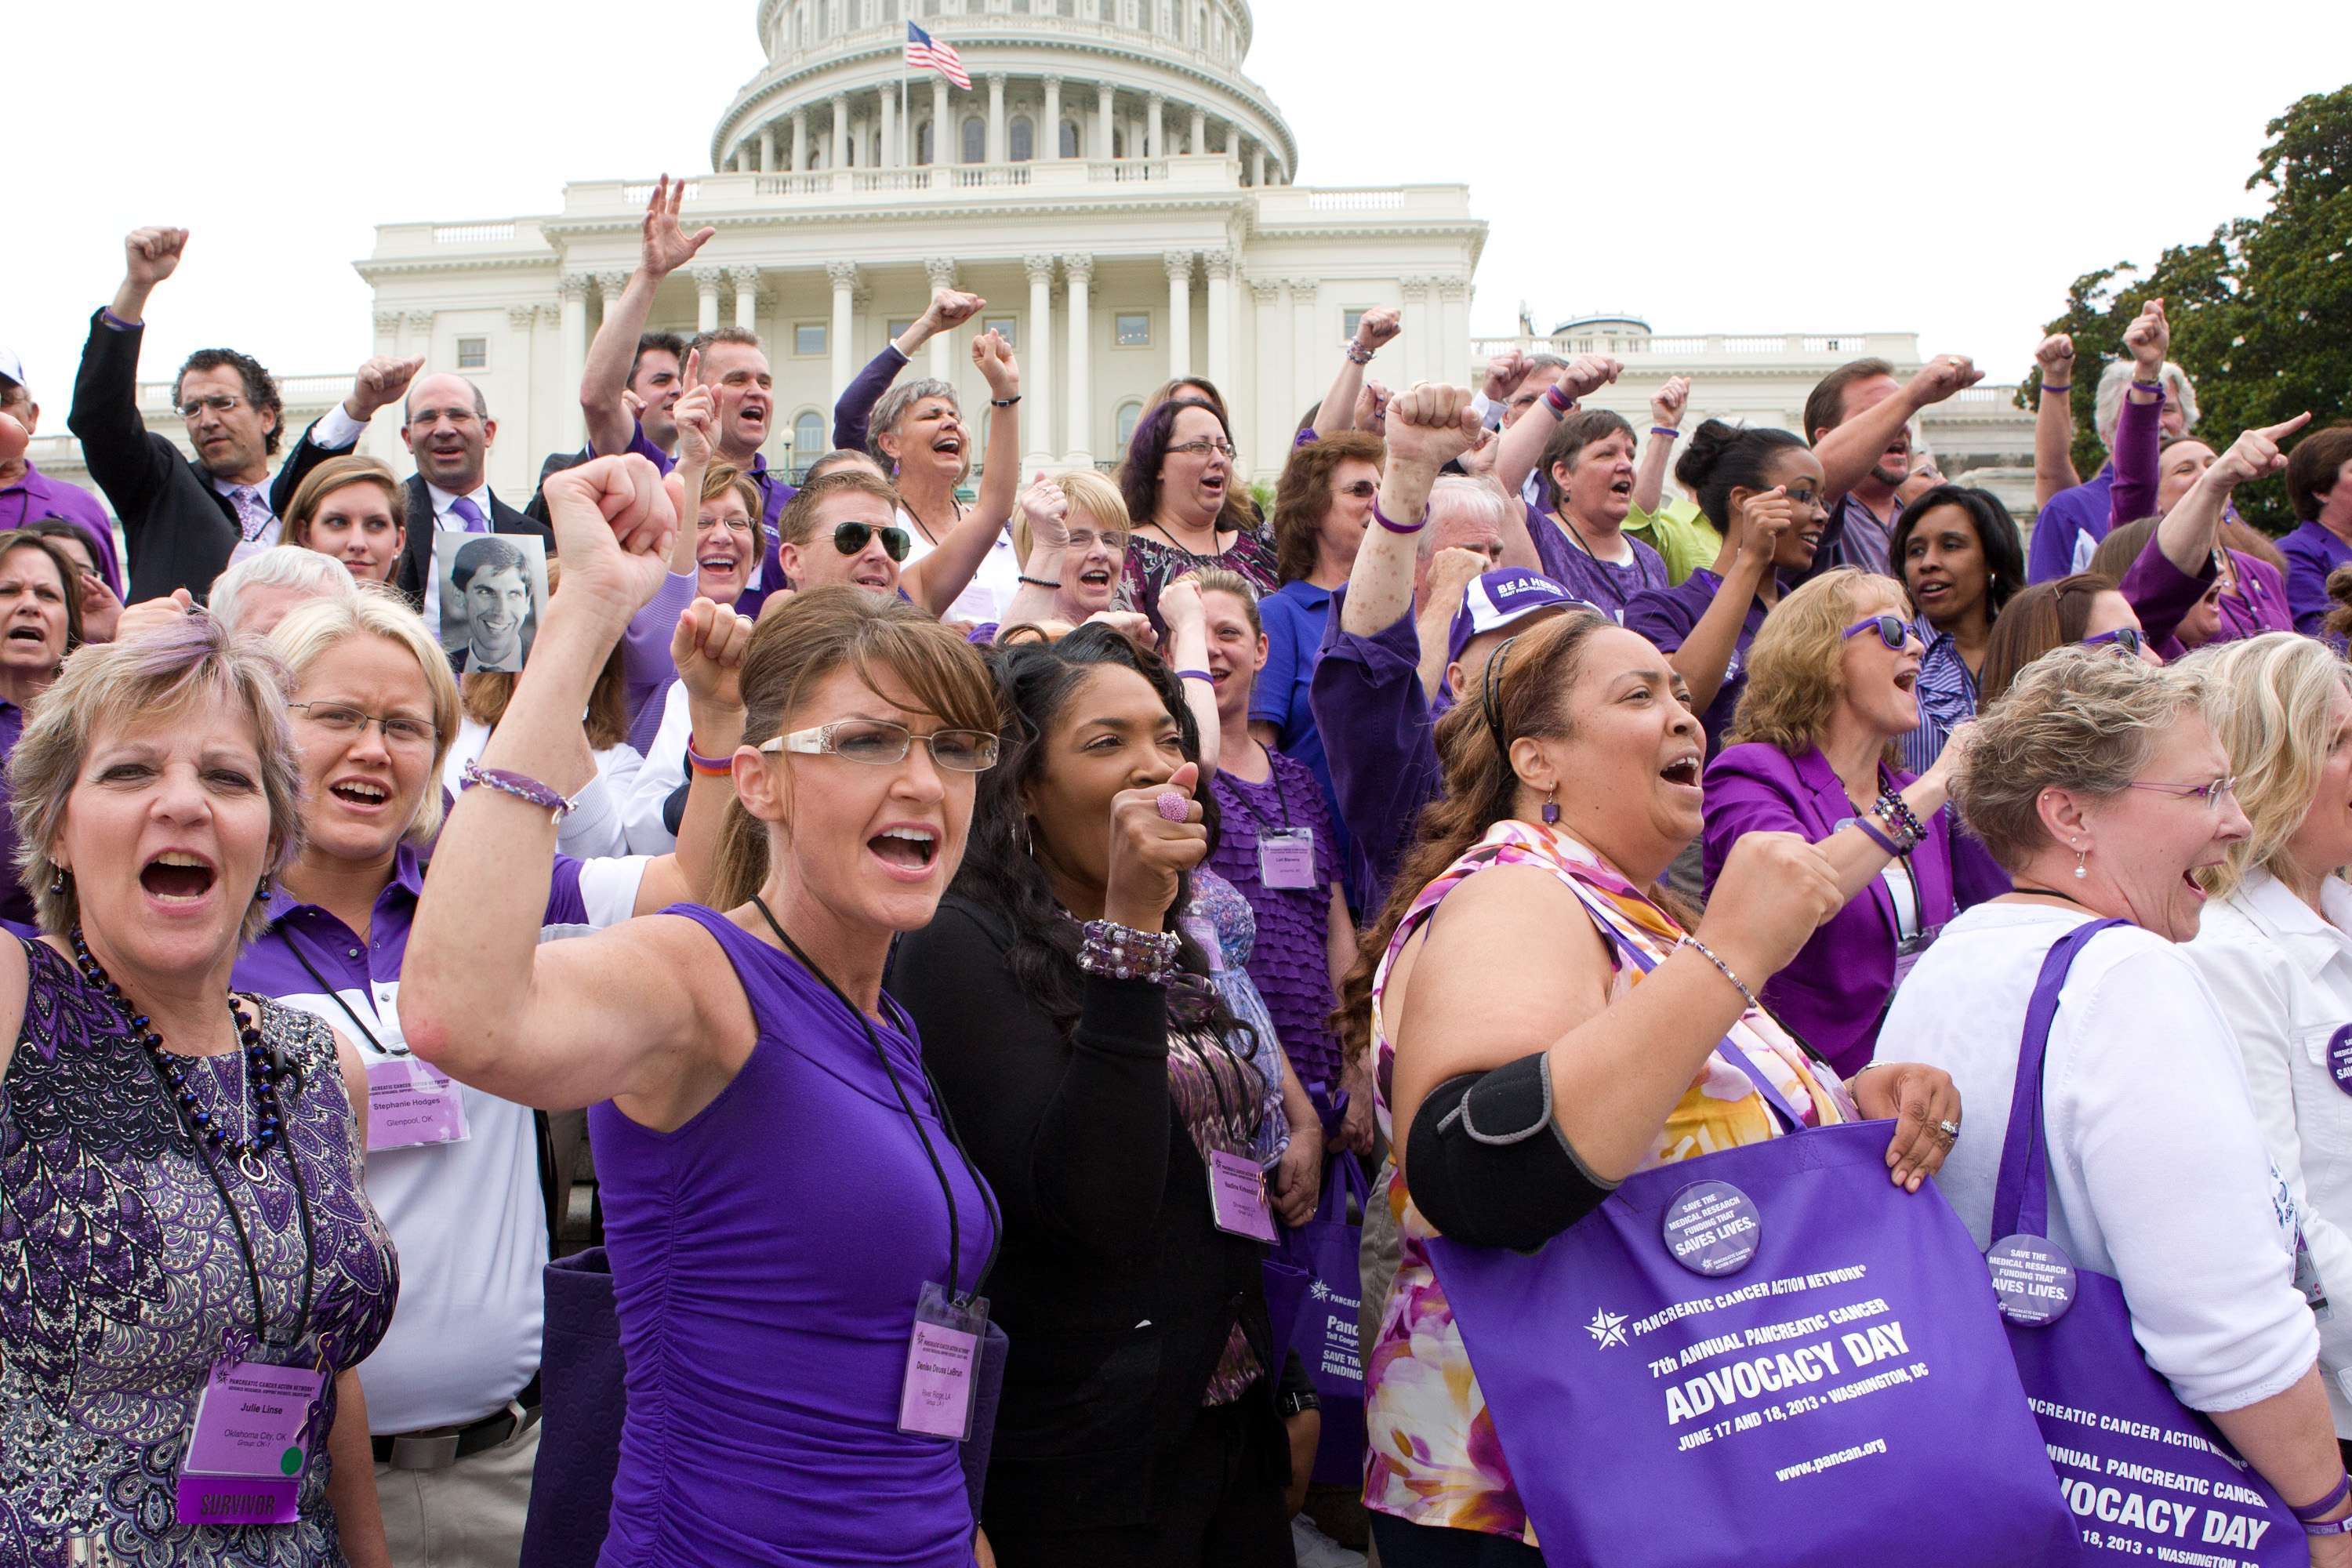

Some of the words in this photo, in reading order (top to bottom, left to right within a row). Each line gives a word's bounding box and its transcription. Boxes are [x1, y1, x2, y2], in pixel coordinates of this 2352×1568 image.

[1497, 581, 1516, 593] BE
[1519, 578, 1528, 588] A
[373, 1101, 411, 1110] Stephanie
[387, 1116, 420, 1127] Glenpool,
[1668, 1212, 1702, 1231] MEDICAL
[1701, 1196, 1740, 1218] RESEARCH
[1682, 1199, 1703, 1213] SAVE
[1701, 1193, 1717, 1205] THE
[1683, 1218, 1717, 1236] FUNDING
[1715, 1210, 1735, 1223] THAT
[1675, 1231, 1716, 1256] SAVES
[1716, 1216, 1756, 1240] LIVES.
[1989, 1256, 2024, 1269] MEDICAL
[2025, 1261, 2067, 1275] RESEARCH
[2010, 1249, 2031, 1259] SAVE
[2031, 1252, 2047, 1261] THE
[1999, 1269, 2033, 1280] FUNDING
[2034, 1273, 2054, 1283] THAT
[2027, 1283, 2068, 1301] LIVES.
[1632, 1298, 1715, 1337] PANCREATIC
[1715, 1283, 1769, 1308] CANCER
[1771, 1276, 1806, 1296] ACTION
[1648, 1356, 1678, 1378] 7th
[1679, 1333, 1745, 1367] ANNUAL
[1744, 1314, 1829, 1346] PANCREATIC
[1831, 1298, 1889, 1325] CANCER
[1323, 1349, 1345, 1363] SAVE
[1321, 1361, 1363, 1381] FUNDING
[1664, 1341, 1840, 1425] ADVOCACY
[1841, 1321, 1910, 1367] DAY
[241, 1403, 260, 1413] Julie
[262, 1405, 282, 1414] Linse
[1678, 1427, 1714, 1451] JUNE
[1714, 1420, 1732, 1438] 17
[1733, 1411, 1762, 1432] AND
[1763, 1406, 1787, 1423] 18,
[1786, 1396, 1820, 1417] 2013
[1828, 1367, 1913, 1404] WASHINGTON,
[1912, 1363, 1929, 1379] DC
[224, 1429, 258, 1439] Oklahoma
[276, 1432, 287, 1441] OK
[2100, 1415, 2160, 1441] CANCER
[2162, 1430, 2209, 1452] ACTION
[1775, 1438, 1887, 1482] www.pancan.org
[2106, 1459, 2209, 1495] PANCREATIC
[2213, 1482, 2268, 1508] CANCER
[201, 1494, 275, 1515] SURVIVOR
[2201, 1509, 2270, 1551] DAY
[2082, 1530, 2103, 1548] 18,
[2107, 1535, 2143, 1555] 2013
